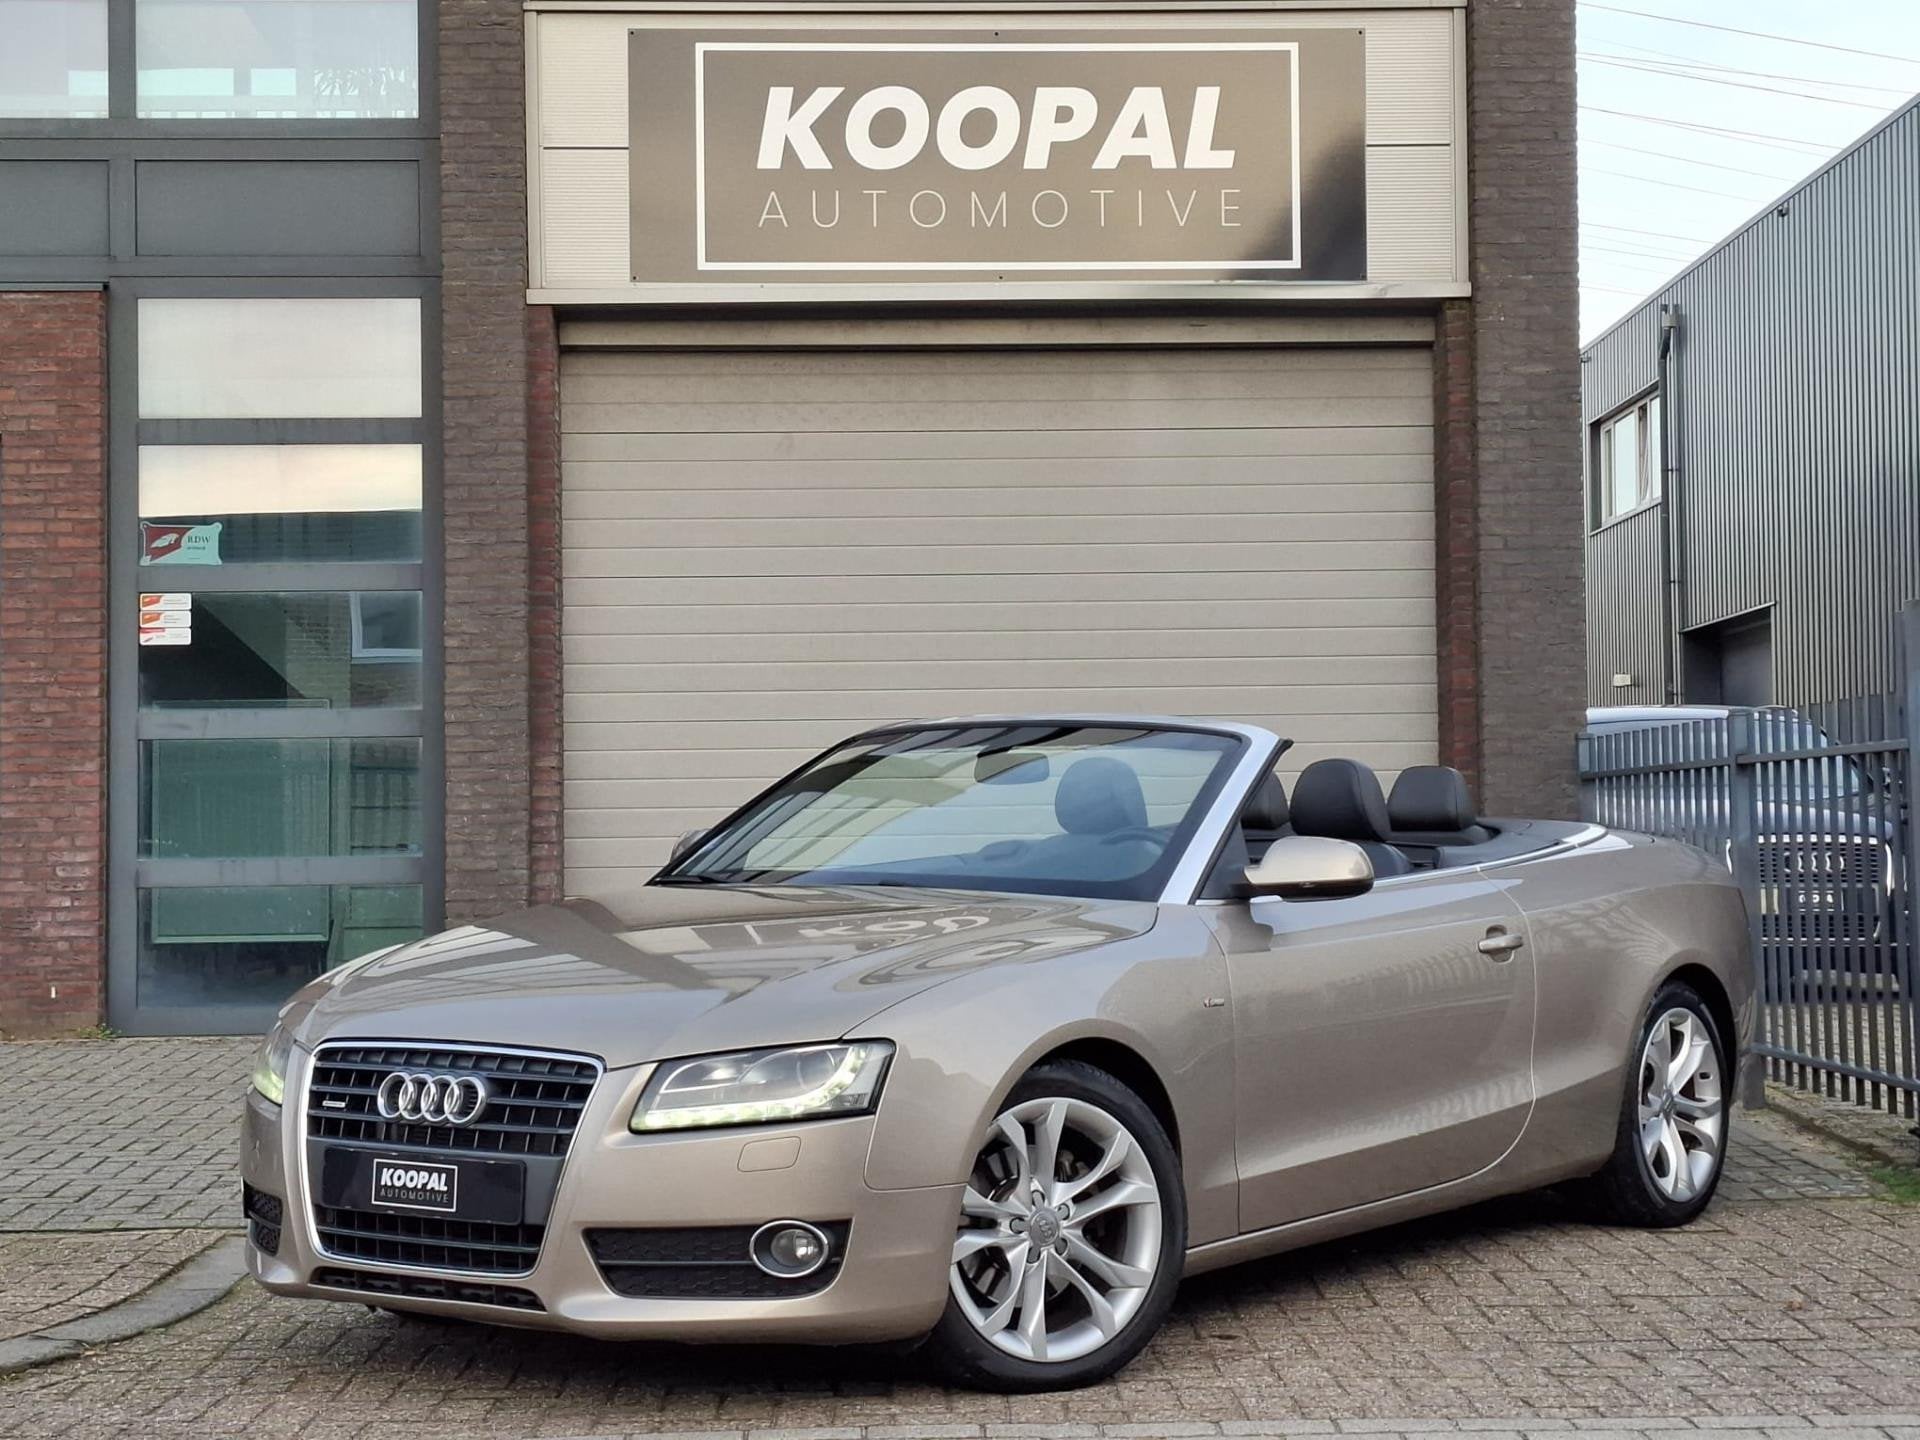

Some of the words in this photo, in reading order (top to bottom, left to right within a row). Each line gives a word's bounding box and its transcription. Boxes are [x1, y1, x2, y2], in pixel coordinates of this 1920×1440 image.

[757, 86, 1236, 170] KOOPAL
[758, 189, 1241, 228] AUTOMOTIVE
[380, 1167, 448, 1191] KOOPAL
[380, 1188, 449, 1203] AUTOMOTIVE
